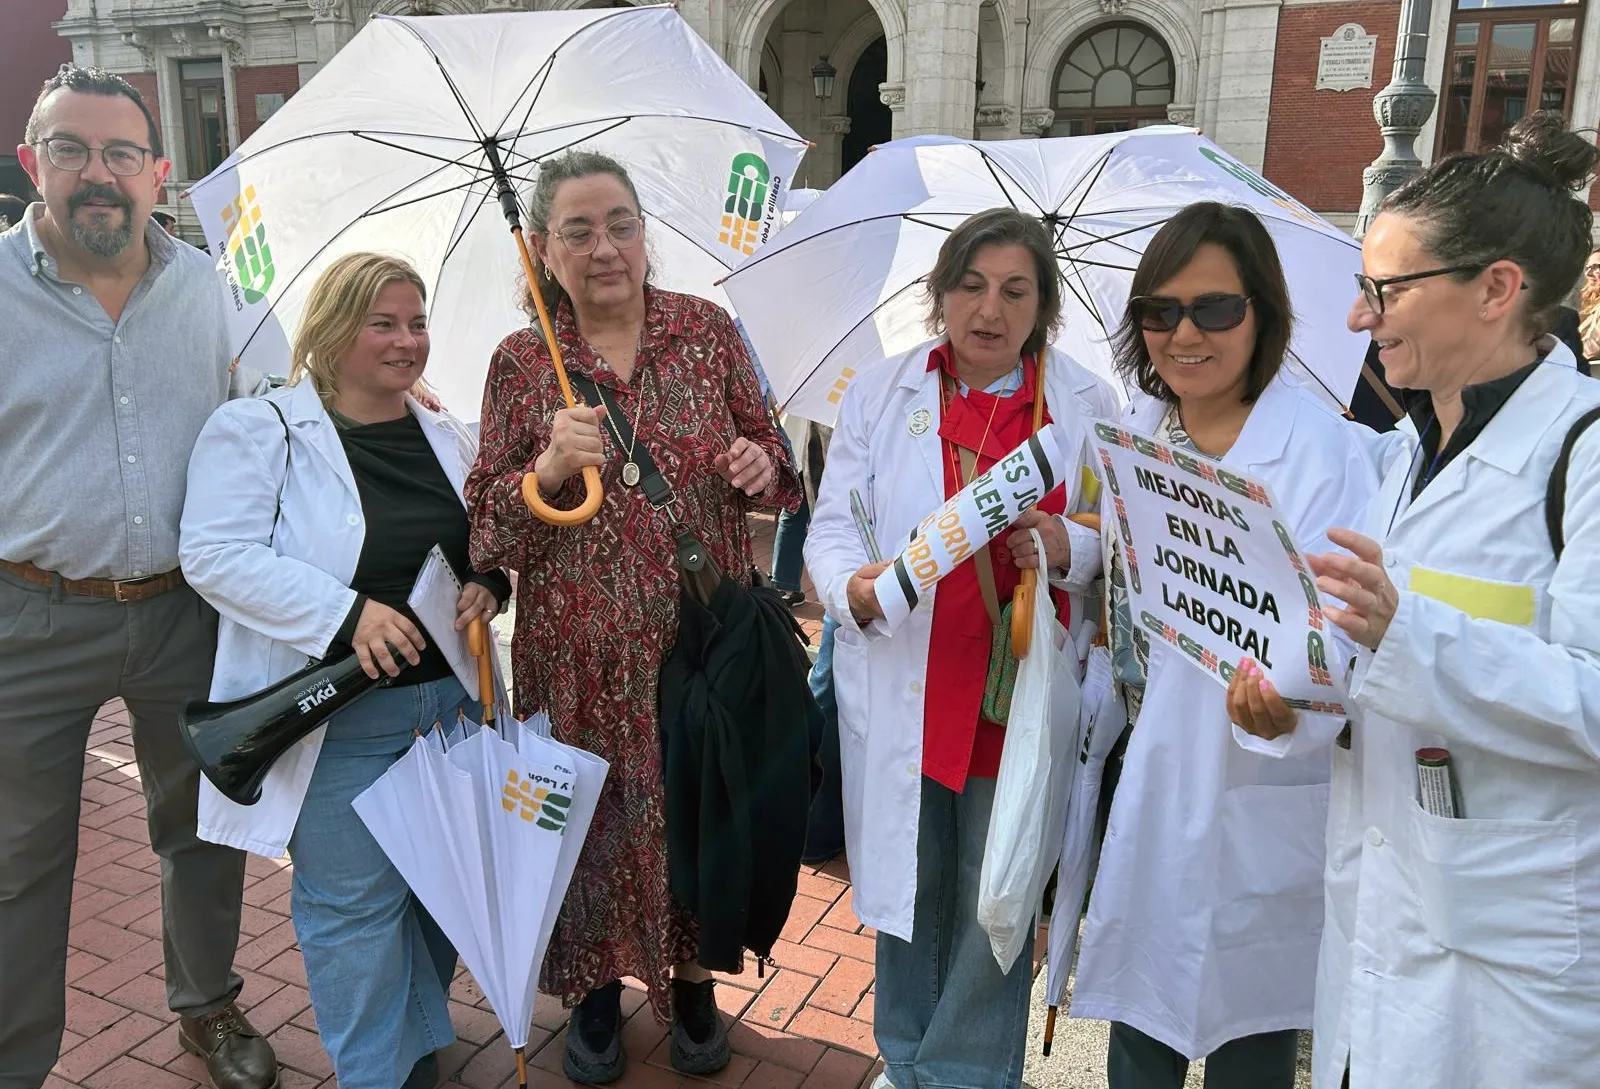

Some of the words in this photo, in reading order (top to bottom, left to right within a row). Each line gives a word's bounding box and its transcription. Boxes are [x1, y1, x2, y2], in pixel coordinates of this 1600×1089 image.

[1001, 450, 1030, 484] ES
[1134, 465, 1250, 532] MEJORAS
[1166, 512, 1201, 547] EN
[1205, 528, 1245, 565] LA
[1153, 543, 1281, 624] JORNADA
[1162, 582, 1272, 670] LABORAL
[298, 683, 338, 714] PYLE
[528, 772, 558, 789] León
